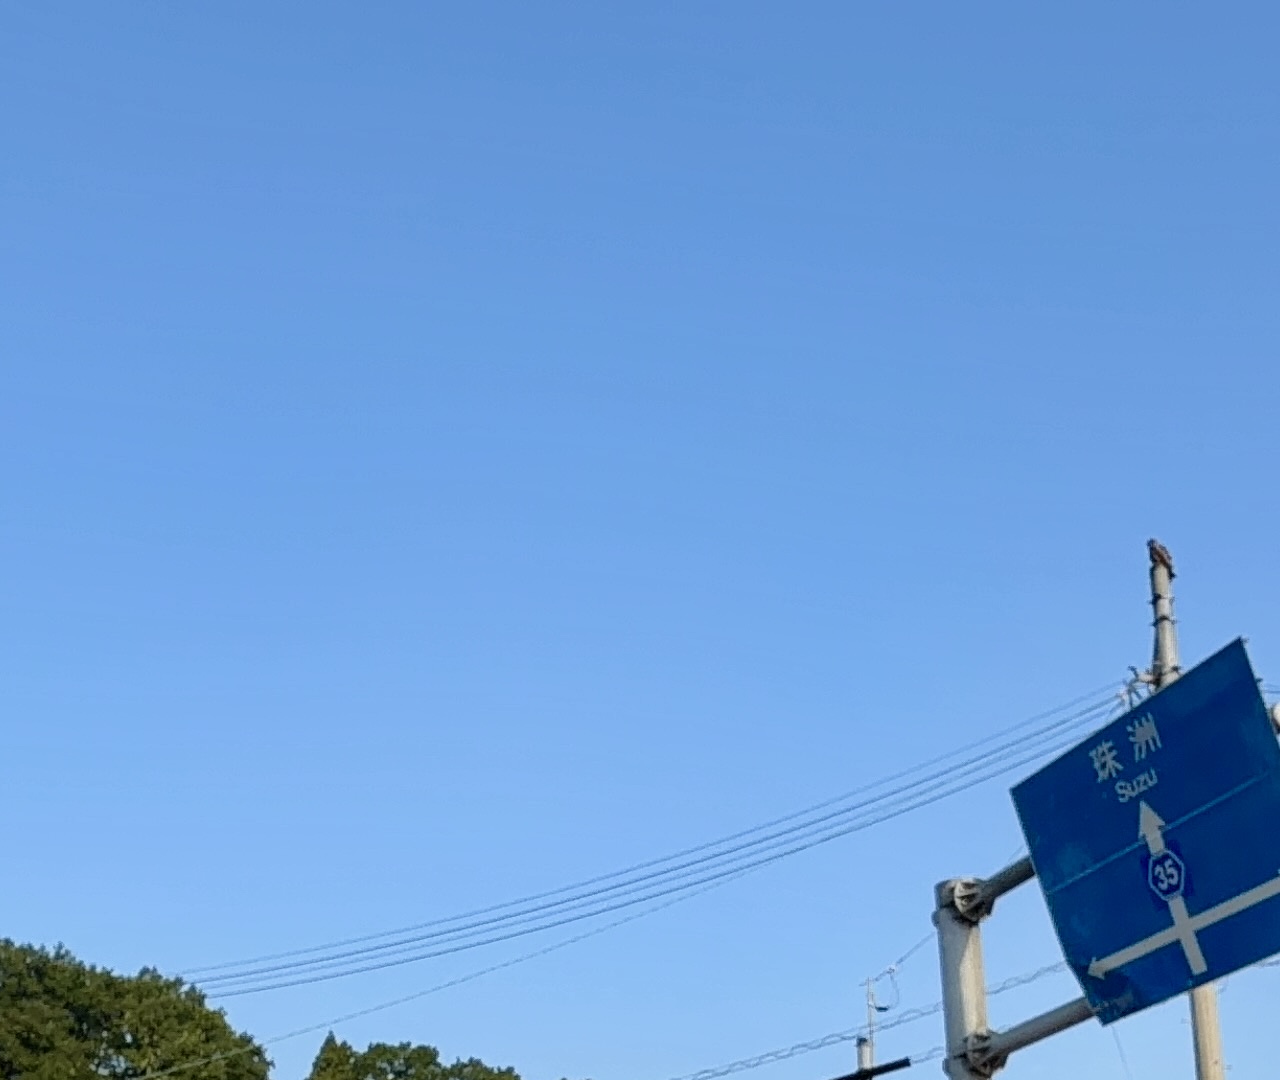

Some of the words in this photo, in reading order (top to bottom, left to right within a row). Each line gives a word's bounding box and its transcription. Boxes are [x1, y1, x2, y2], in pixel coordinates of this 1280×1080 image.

[1089, 712, 1162, 783] 珠洲
[1115, 767, 1158, 803] Suzu
[1154, 858, 1179, 891] 35
